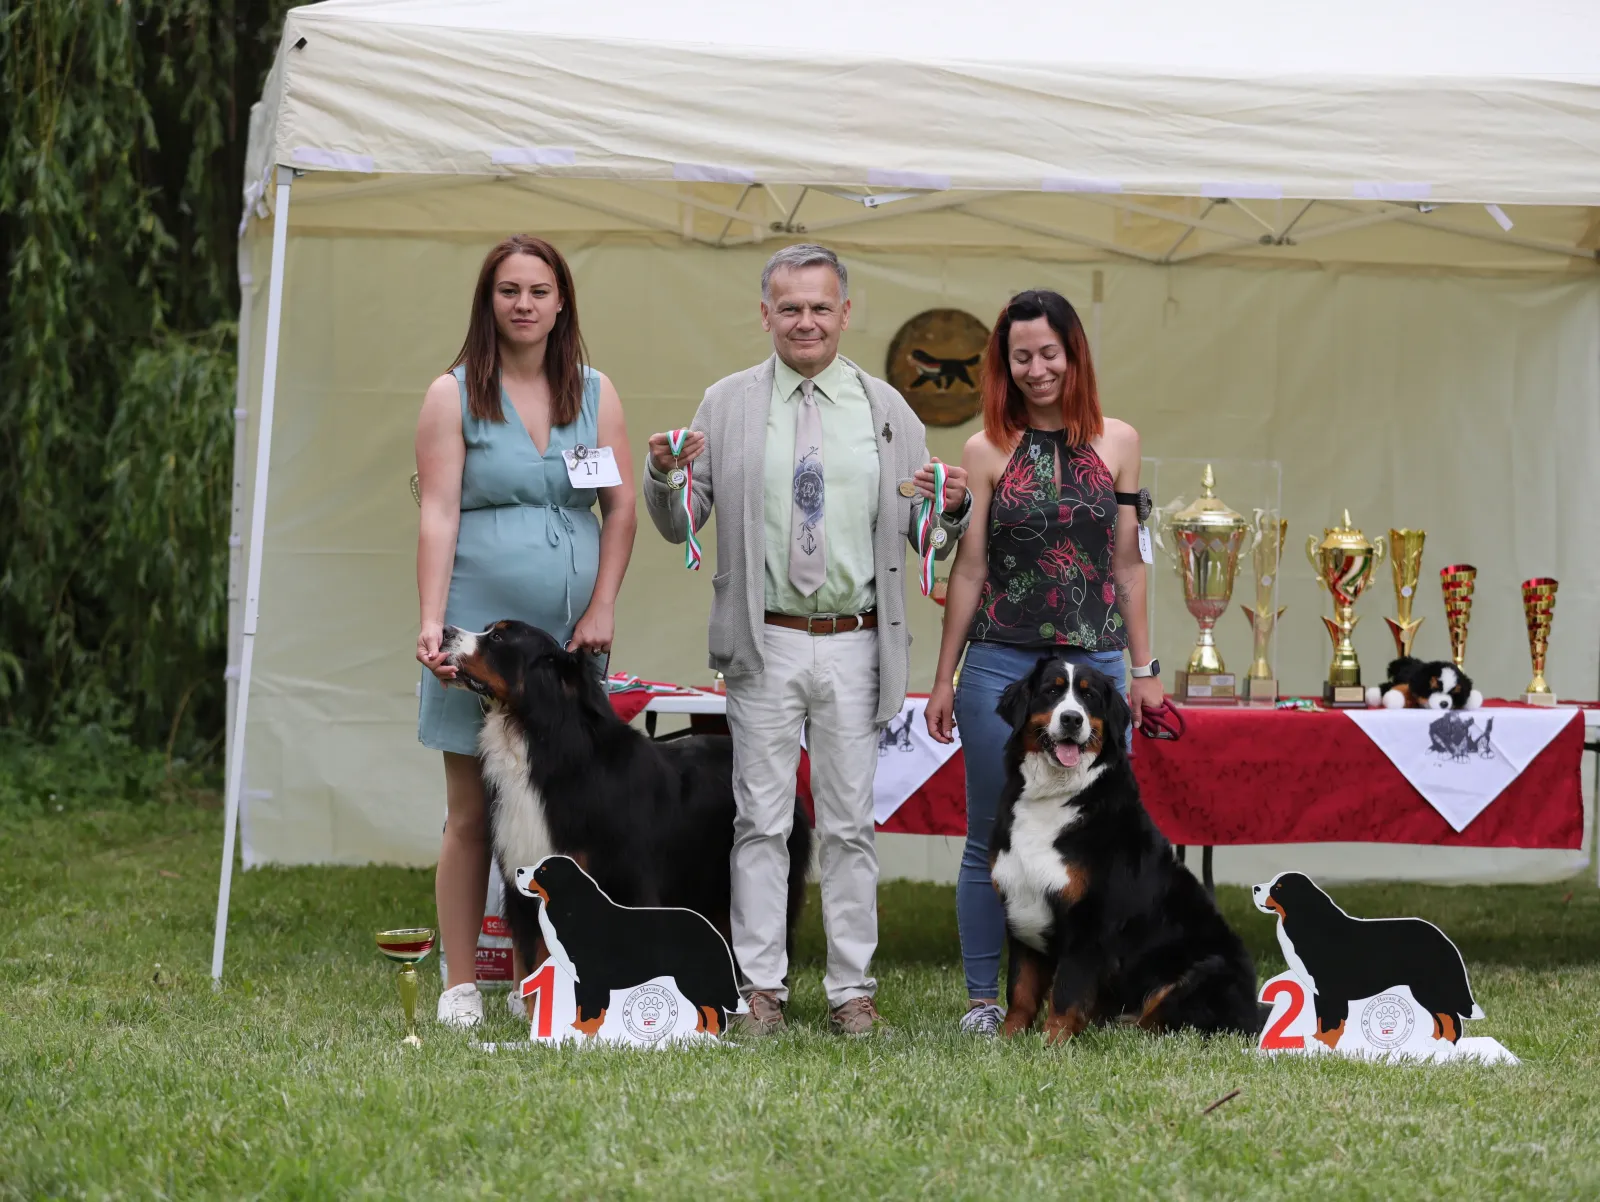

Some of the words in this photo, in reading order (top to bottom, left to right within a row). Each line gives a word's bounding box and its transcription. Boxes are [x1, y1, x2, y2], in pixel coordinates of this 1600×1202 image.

[584, 462, 598, 476] 17
[475, 950, 489, 958] ULT
[523, 965, 555, 1037] 1
[1262, 980, 1305, 1050] 2
